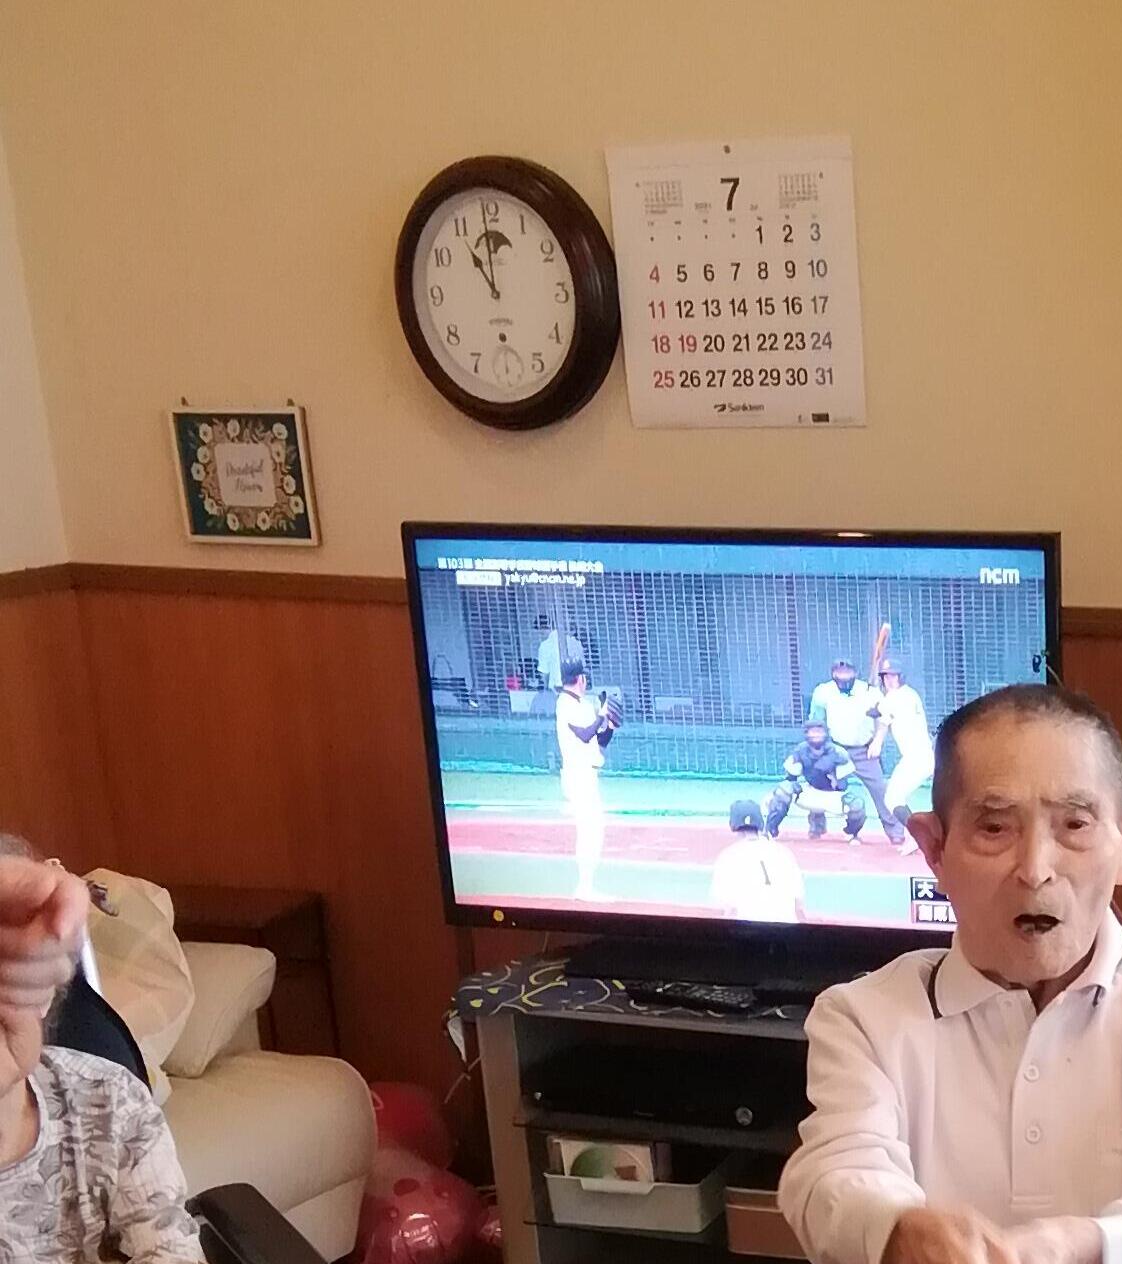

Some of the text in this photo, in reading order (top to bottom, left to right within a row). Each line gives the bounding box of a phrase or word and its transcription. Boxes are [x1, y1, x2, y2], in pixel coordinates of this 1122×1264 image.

[720, 177, 740, 211] 7
[481, 199, 499, 223] 2
[454, 216, 469, 237] 11
[519, 214, 527, 234] 1
[755, 222, 821, 244] 1 2 3
[434, 246, 452, 268] 10
[540, 239, 555, 263] 2
[649, 259, 828, 283] 4 5 6 7 8 9 10
[430, 285, 444, 307] 9
[554, 282, 569, 304] 3
[648, 296, 829, 319] 11 12 13 14 15 16 17
[446, 324, 460, 346] 8
[548, 321, 563, 345] 4
[651, 331, 832, 354] 18 19 20 21 22 23 24
[470, 352, 482, 374] 7
[531, 352, 545, 373] 5
[653, 367, 833, 389] 25 26 27 28 29 30 31
[980, 567, 1020, 585] ncm
